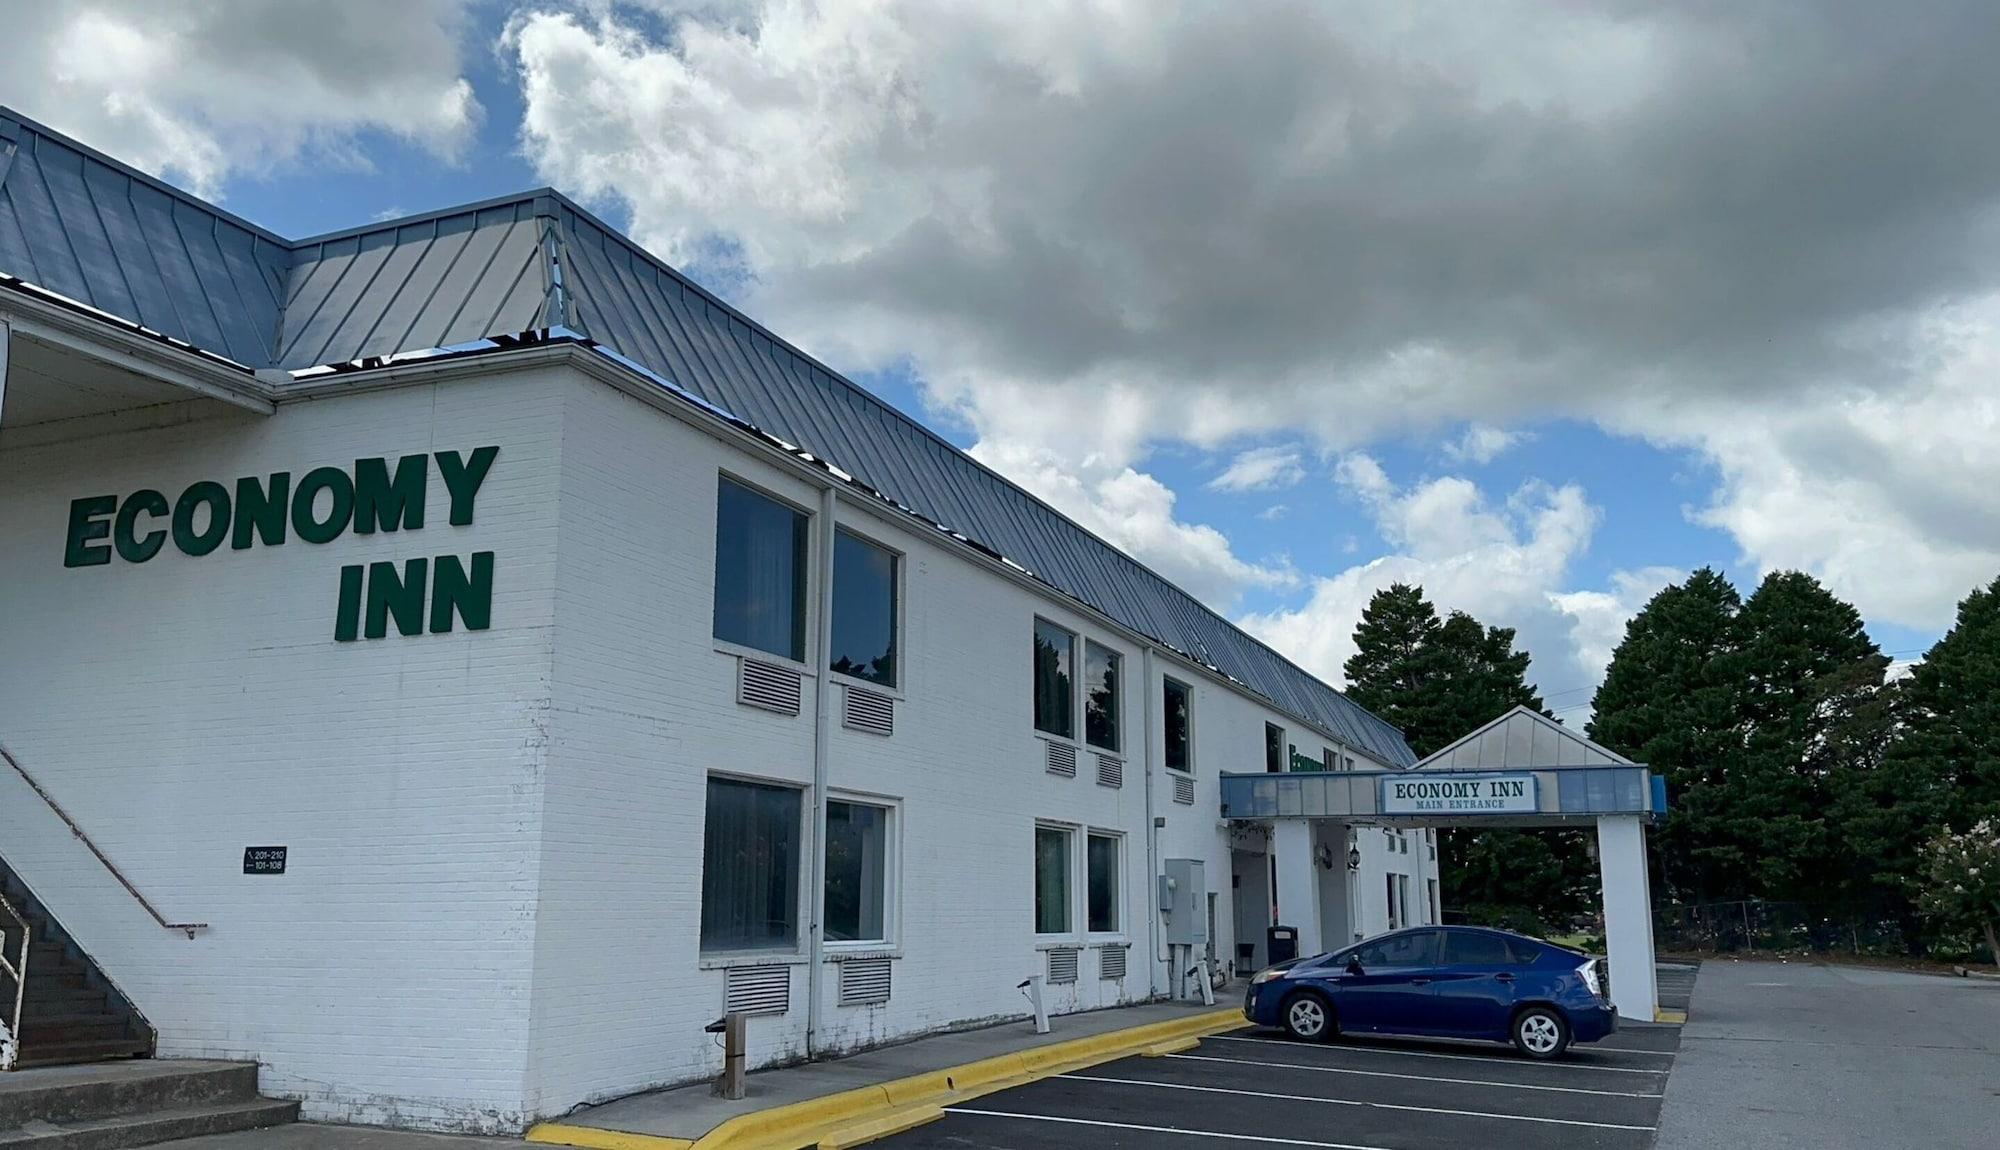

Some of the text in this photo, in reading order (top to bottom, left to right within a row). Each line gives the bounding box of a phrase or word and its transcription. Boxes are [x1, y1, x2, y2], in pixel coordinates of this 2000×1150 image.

[64, 445, 500, 568] ECONOMY
[334, 551, 494, 642] INN
[1395, 781, 1524, 799] ECONOMY INN
[1416, 800, 1505, 809] MAIN ENTRANCE
[255, 851, 284, 860] 201-210
[255, 861, 282, 870] 101-108
